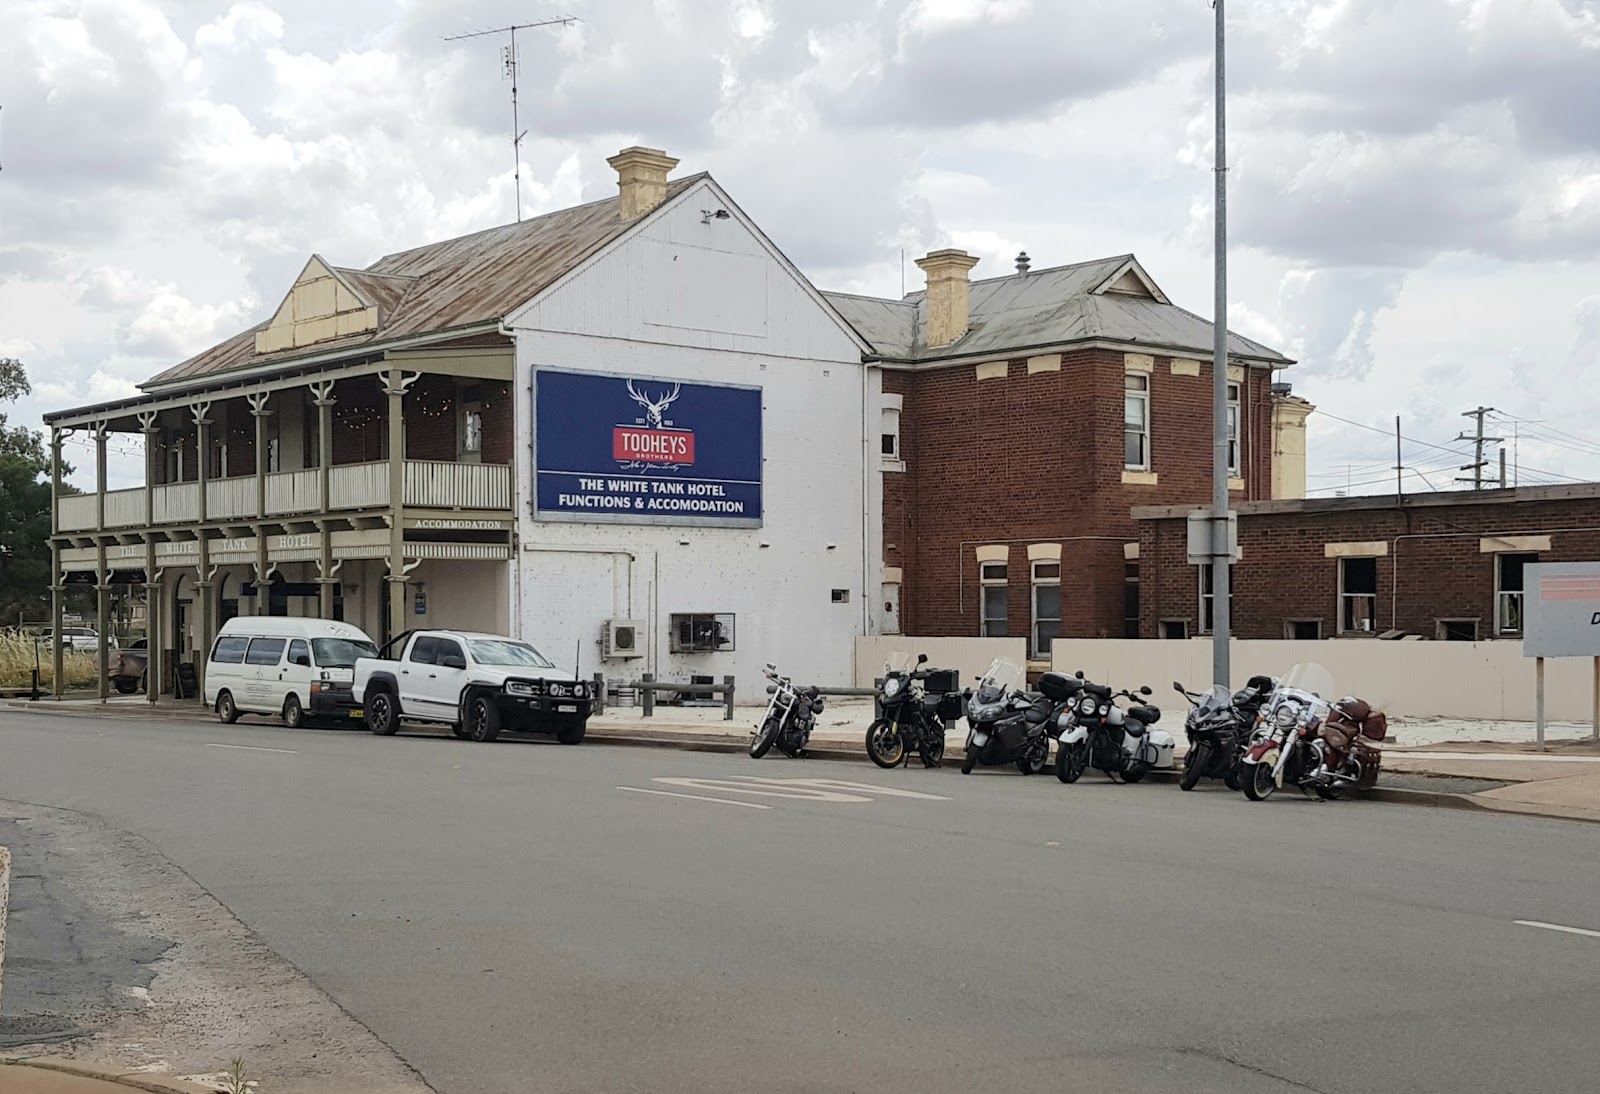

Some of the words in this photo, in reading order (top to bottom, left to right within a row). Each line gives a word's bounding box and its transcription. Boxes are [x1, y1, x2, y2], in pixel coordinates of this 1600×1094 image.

[621, 432, 687, 455] TOOHEYS
[635, 452, 674, 460] BROTHERS
[579, 478, 604, 491] THE
[607, 480, 648, 493] WHITE
[651, 482, 685, 494] TANK
[688, 484, 726, 496] HOTEL
[559, 494, 631, 508] FUNCTIONS
[634, 497, 644, 509] &
[647, 498, 744, 513] ACCOMODATION
[415, 520, 502, 529] ACCOMMODATION
[120, 546, 137, 557] THE
[165, 542, 194, 554] WHITE
[221, 539, 248, 551] TANK
[279, 535, 313, 548] HOTEL
